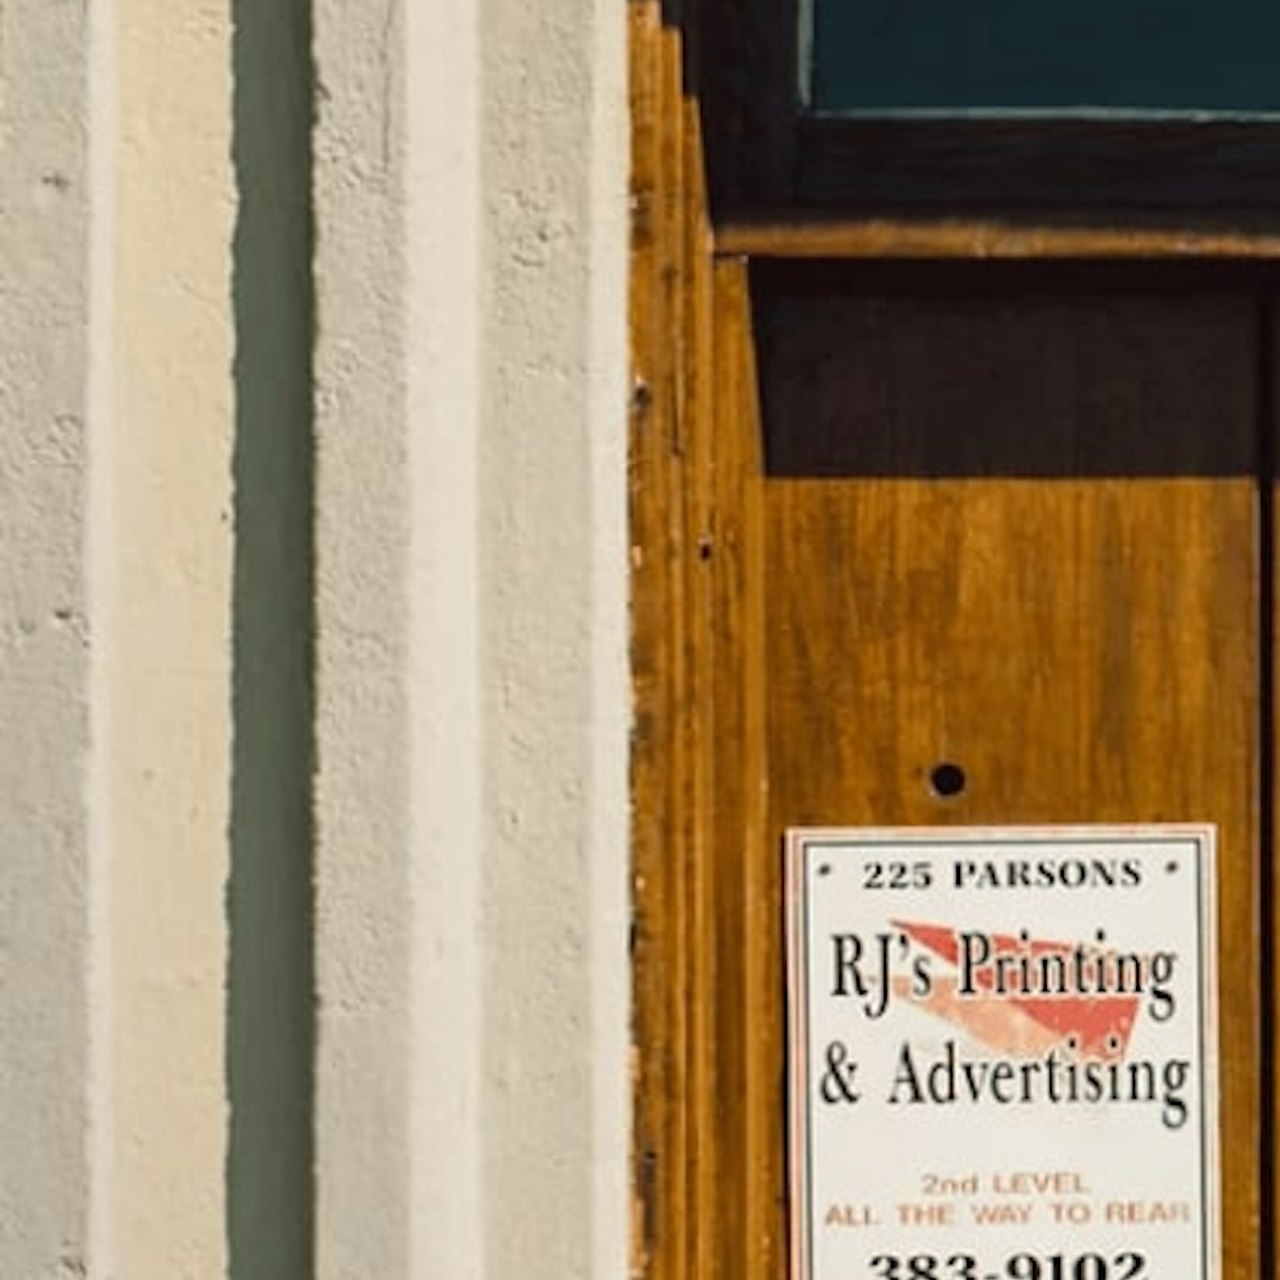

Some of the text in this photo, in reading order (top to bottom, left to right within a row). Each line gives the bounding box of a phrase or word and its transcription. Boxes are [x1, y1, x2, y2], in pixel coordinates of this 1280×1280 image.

[863, 859, 1142, 889] 225 PARSONS
[830, 929, 1176, 1020] RJ's Printing
[820, 1037, 1190, 1129] & Advertising
[922, 1172, 1090, 1194] 2nd LEVEL
[825, 1200, 1190, 1225] ALL THE WAY TO REAR
